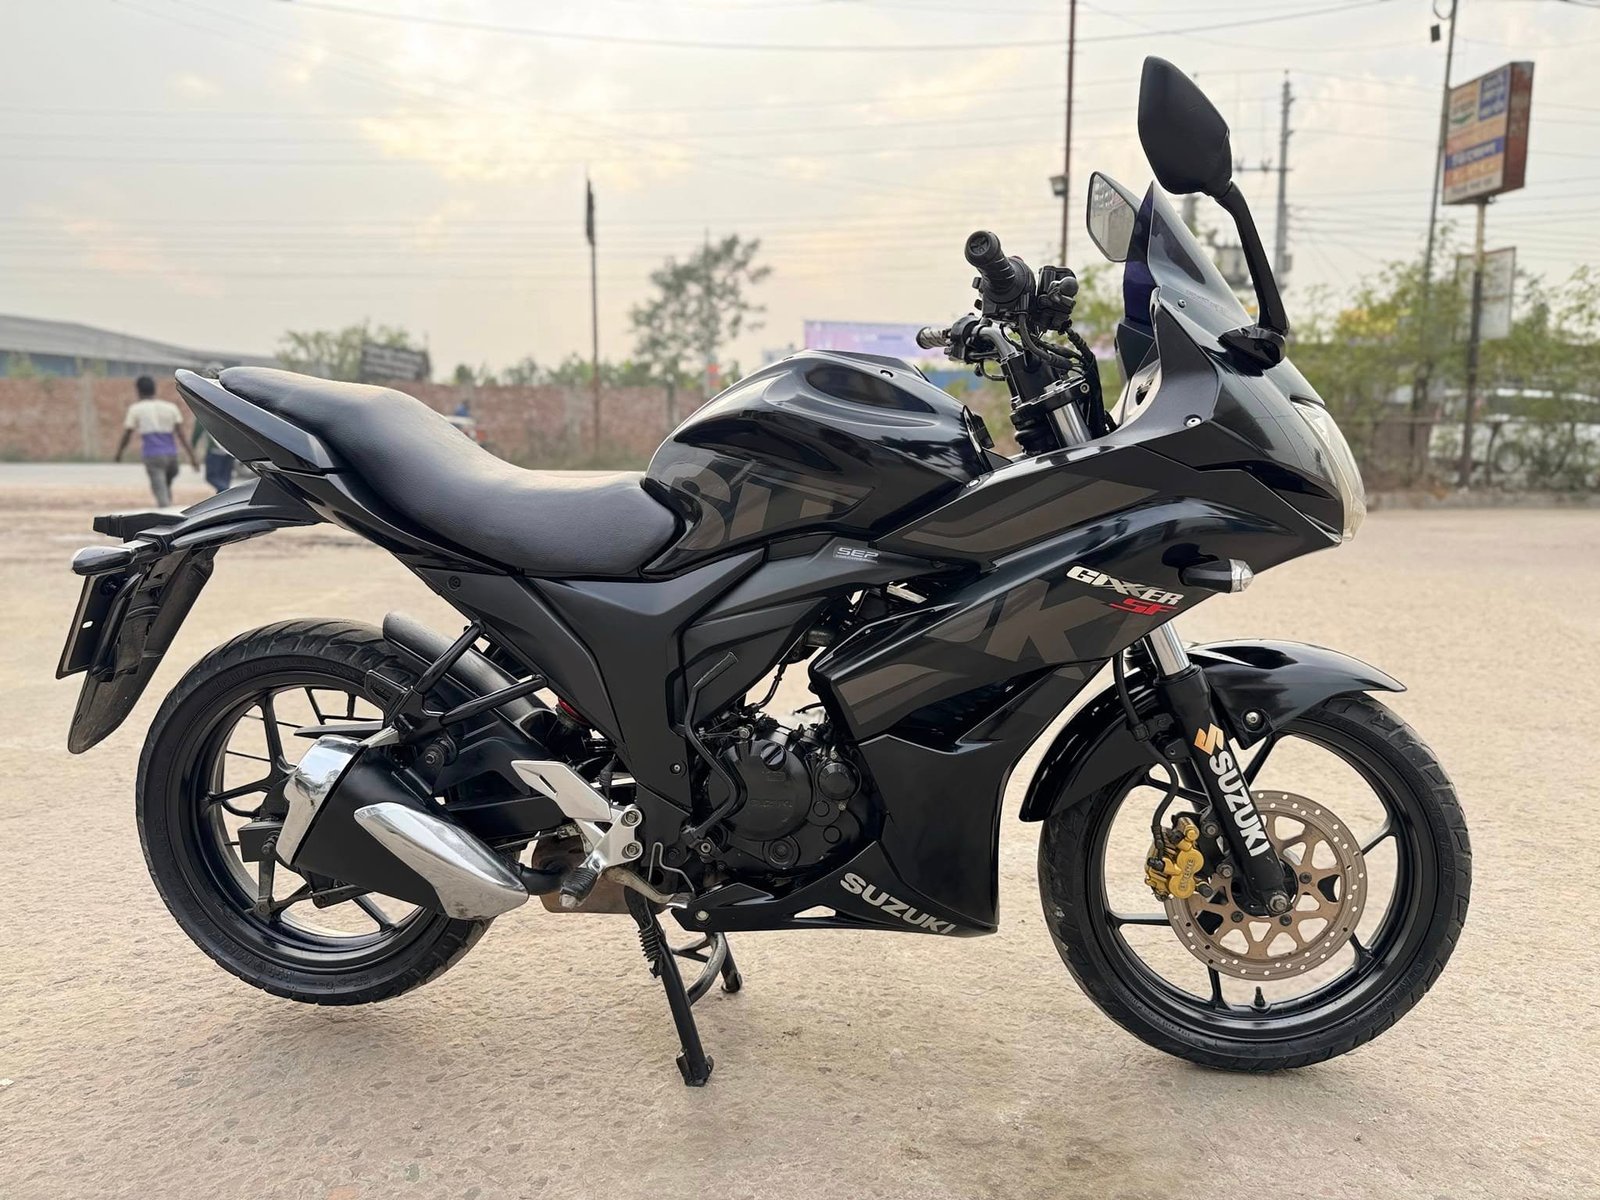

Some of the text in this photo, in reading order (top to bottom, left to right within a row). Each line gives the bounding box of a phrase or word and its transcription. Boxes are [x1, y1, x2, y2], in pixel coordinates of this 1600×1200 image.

[837, 546, 879, 558] SEP
[1066, 565, 1184, 605] GIXXER
[1109, 598, 1179, 616] SF
[1209, 750, 1271, 857] SUZUKI
[840, 872, 957, 935] SUZUKI
